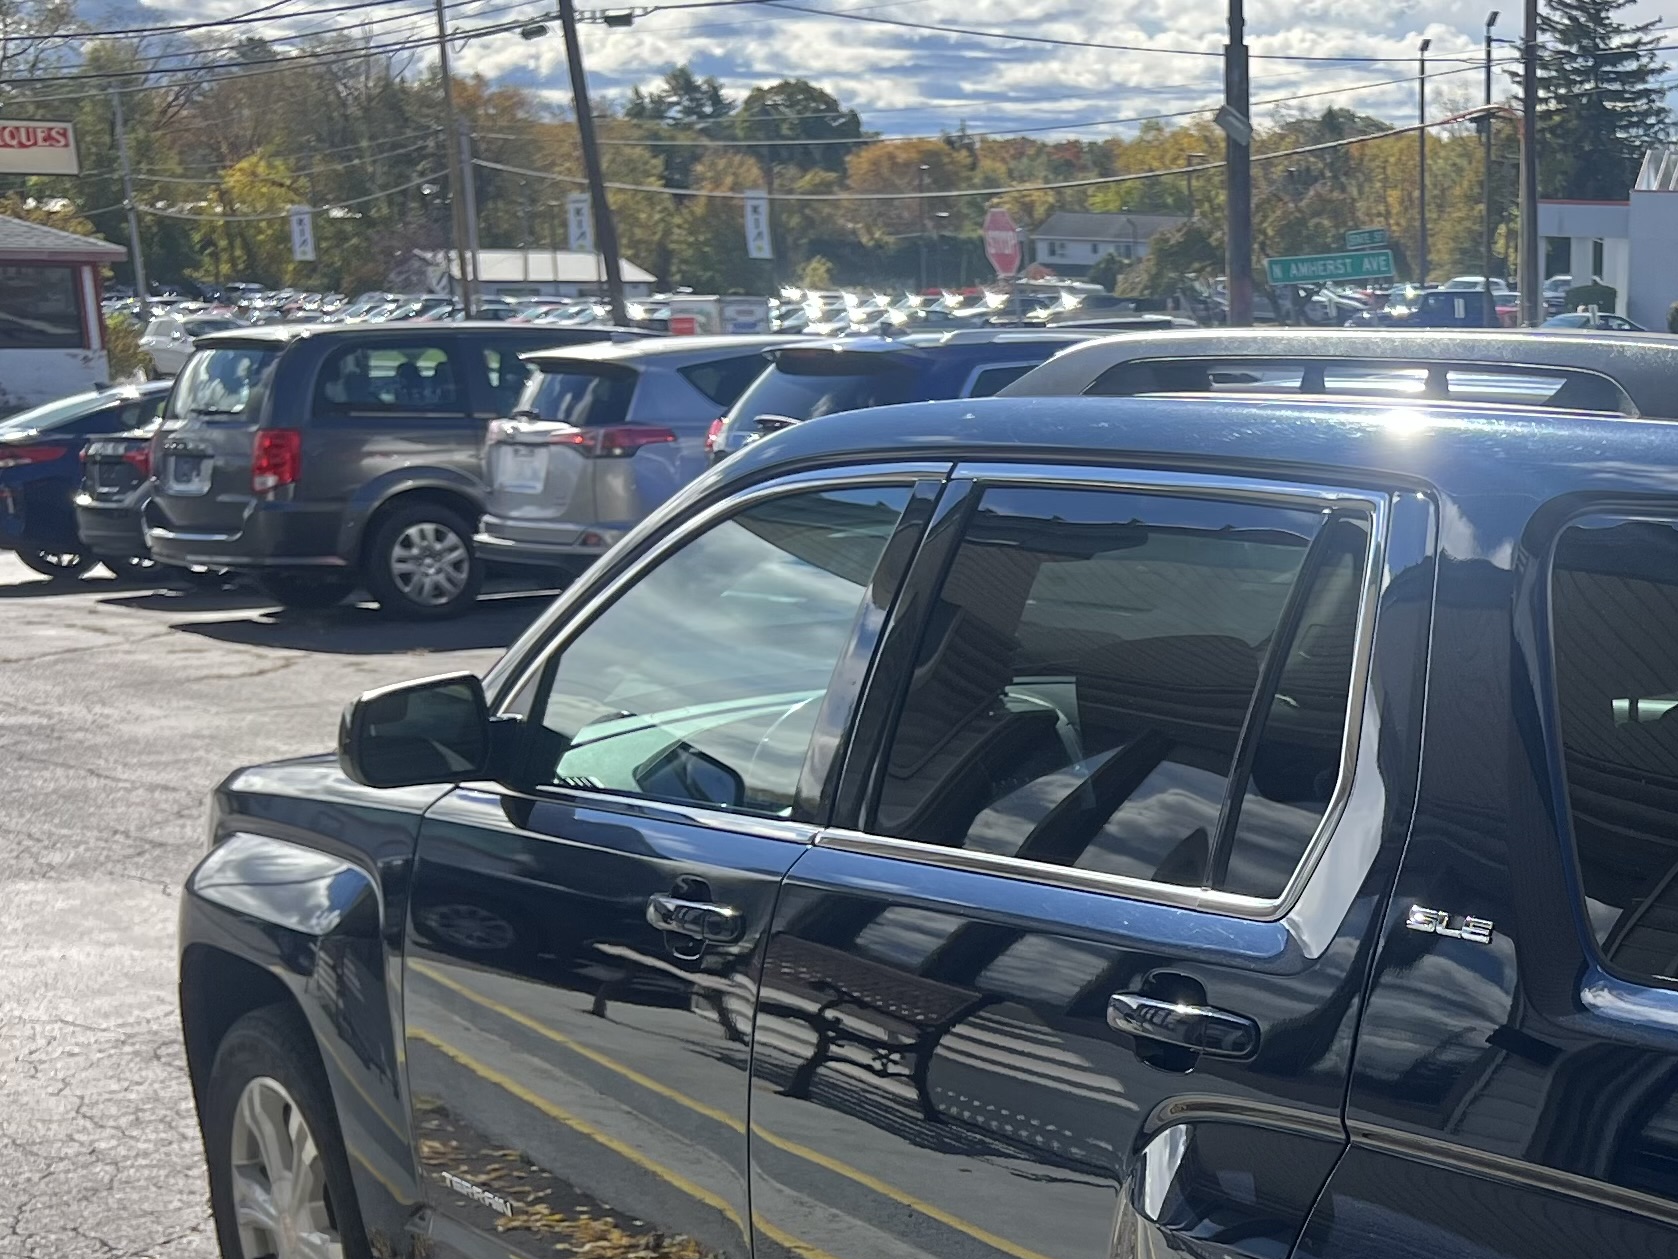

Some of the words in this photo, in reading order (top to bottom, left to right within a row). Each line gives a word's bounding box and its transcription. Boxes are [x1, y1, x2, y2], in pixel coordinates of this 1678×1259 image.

[1271, 263, 1283, 279] N
[1289, 259, 1353, 278] AMHERST
[1362, 256, 1389, 272] AVE
[1406, 904, 1494, 944] SLE
[440, 1170, 513, 1218] TERRAIN
